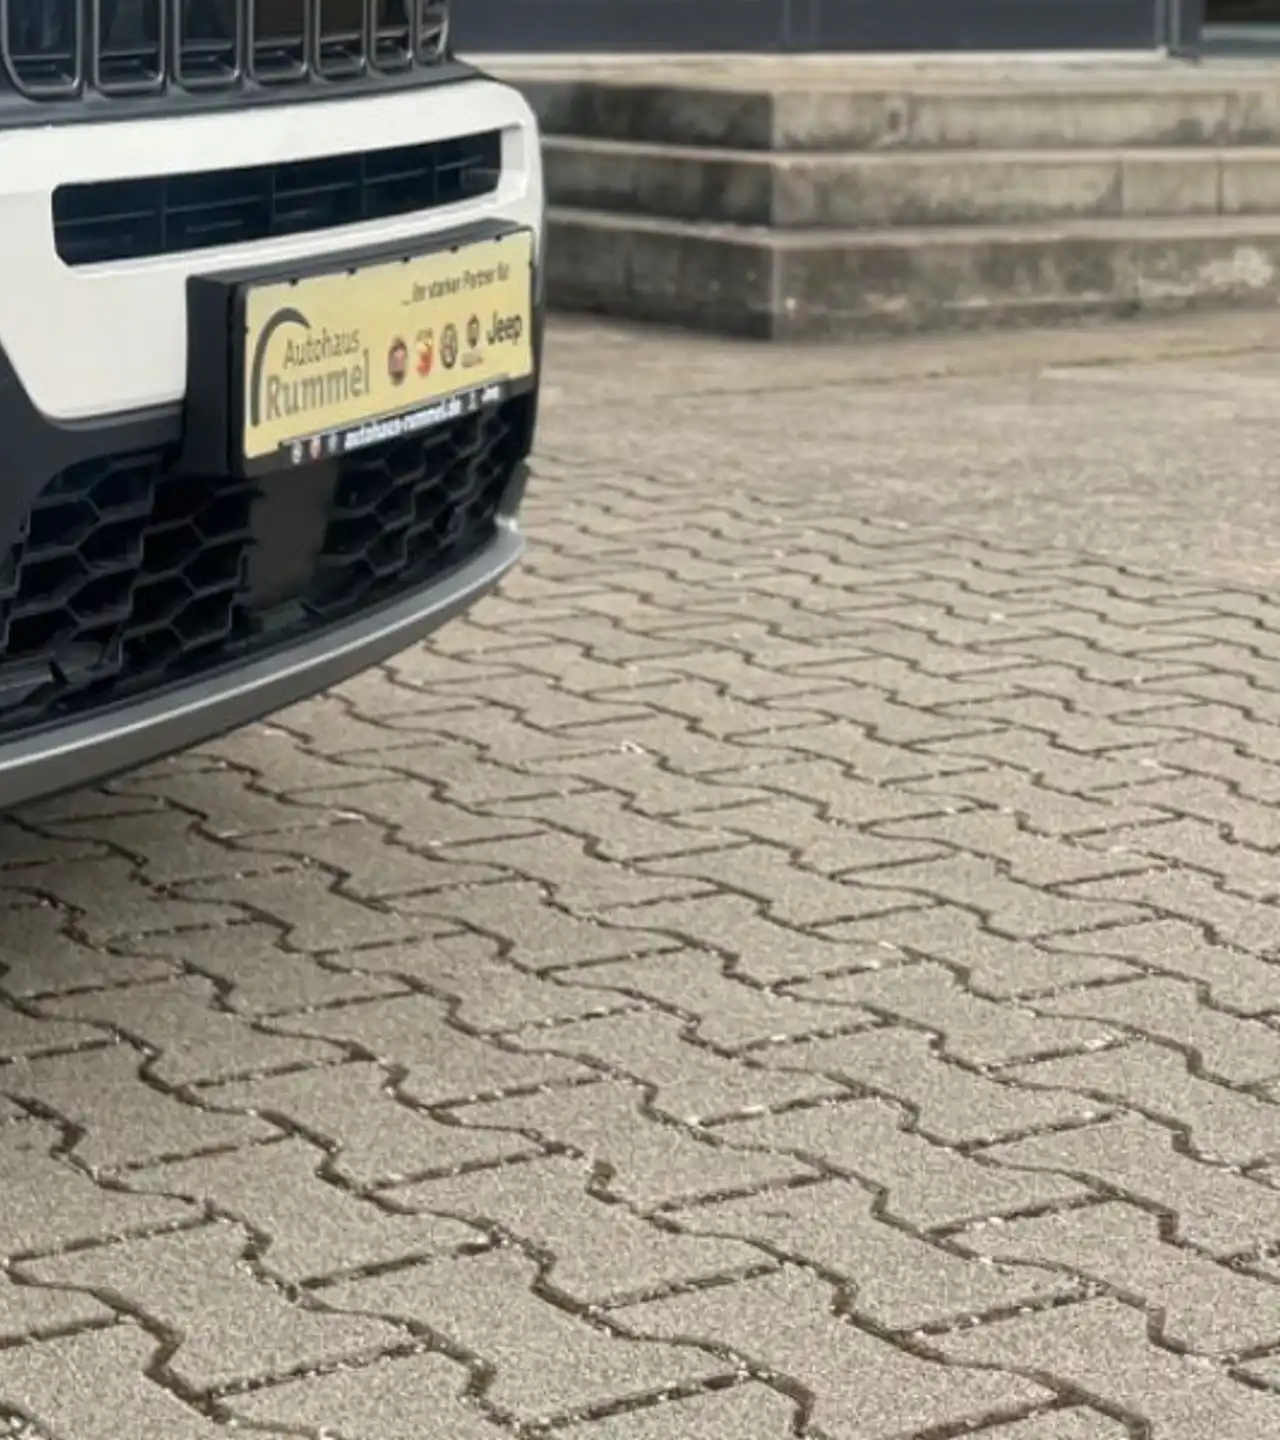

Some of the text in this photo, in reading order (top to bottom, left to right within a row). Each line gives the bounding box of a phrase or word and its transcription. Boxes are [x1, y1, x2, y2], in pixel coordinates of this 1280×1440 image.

[282, 326, 360, 370] Autohaus
[486, 310, 522, 346] Jeep
[266, 347, 369, 422] Rummel
